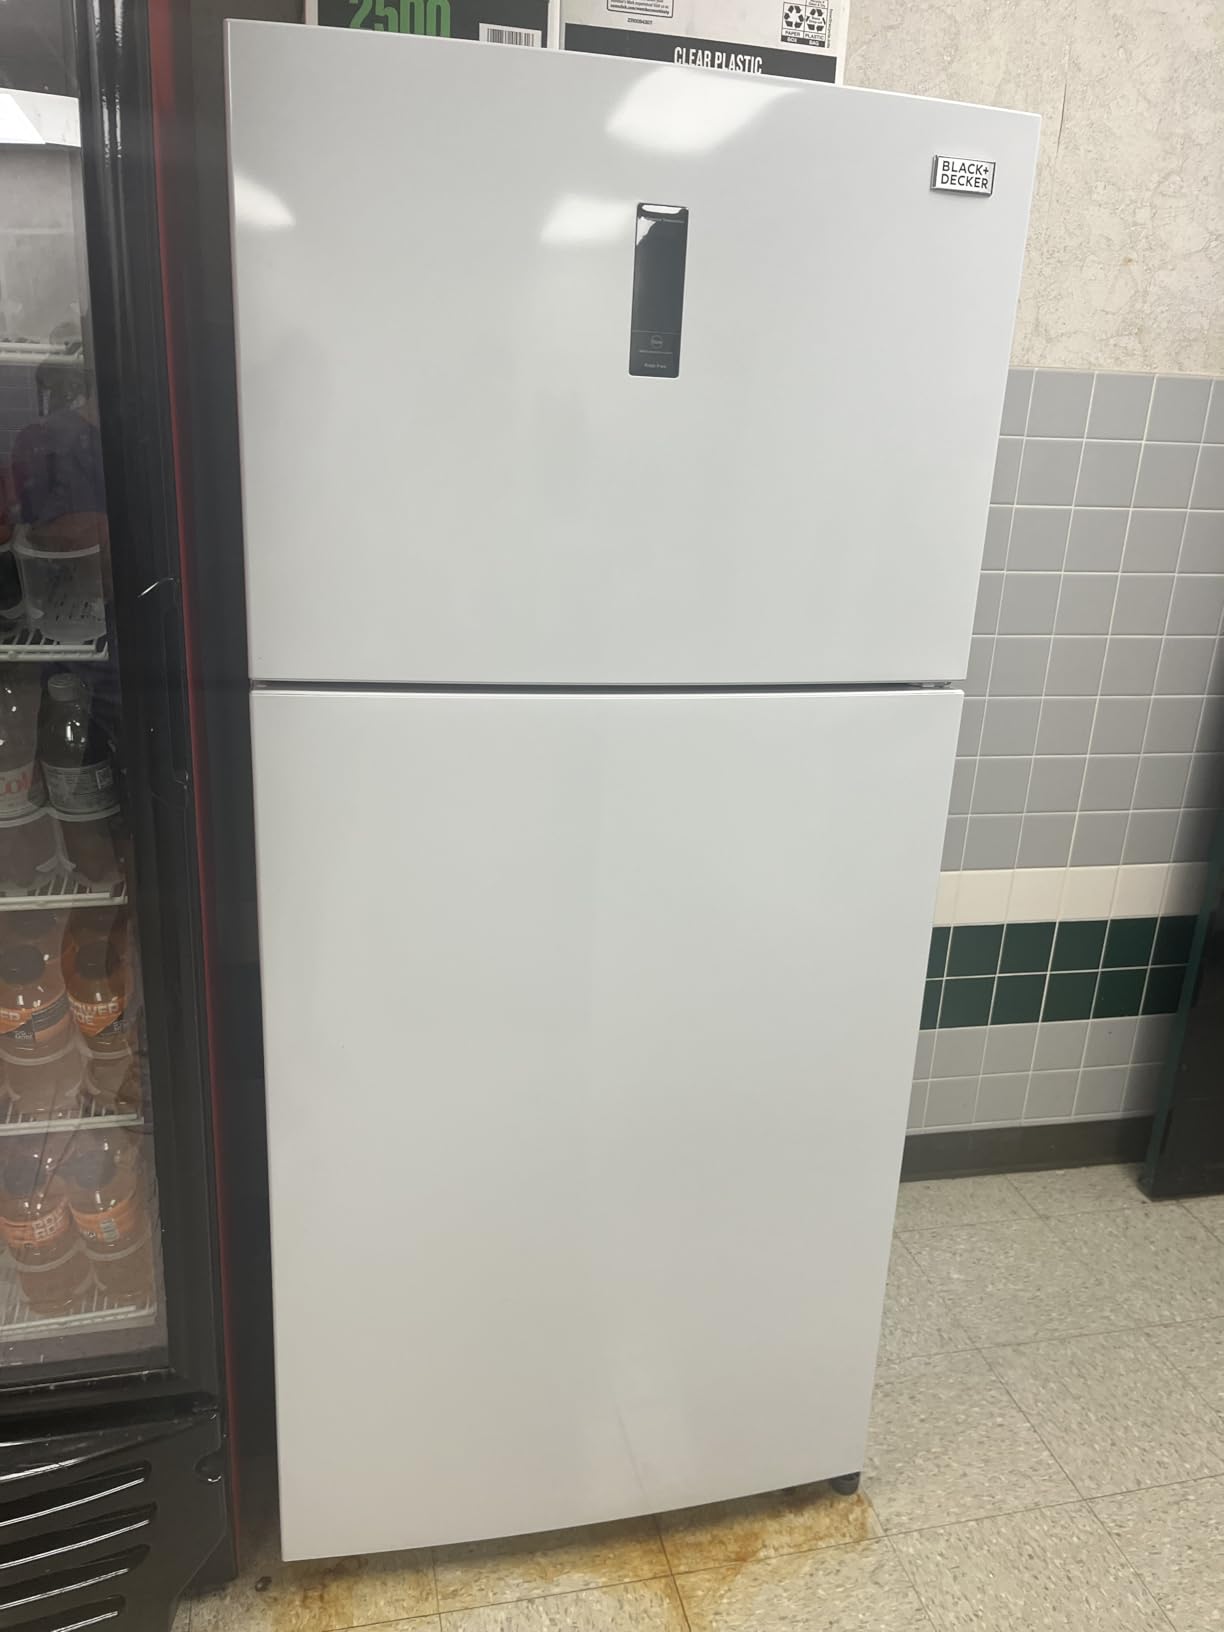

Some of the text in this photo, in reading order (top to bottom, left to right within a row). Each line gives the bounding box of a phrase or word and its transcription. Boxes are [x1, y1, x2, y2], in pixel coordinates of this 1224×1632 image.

[674, 46, 763, 74] CLEAR PLASTIC
[942, 160, 989, 175] BLACK+
[941, 173, 988, 189] DECKER
